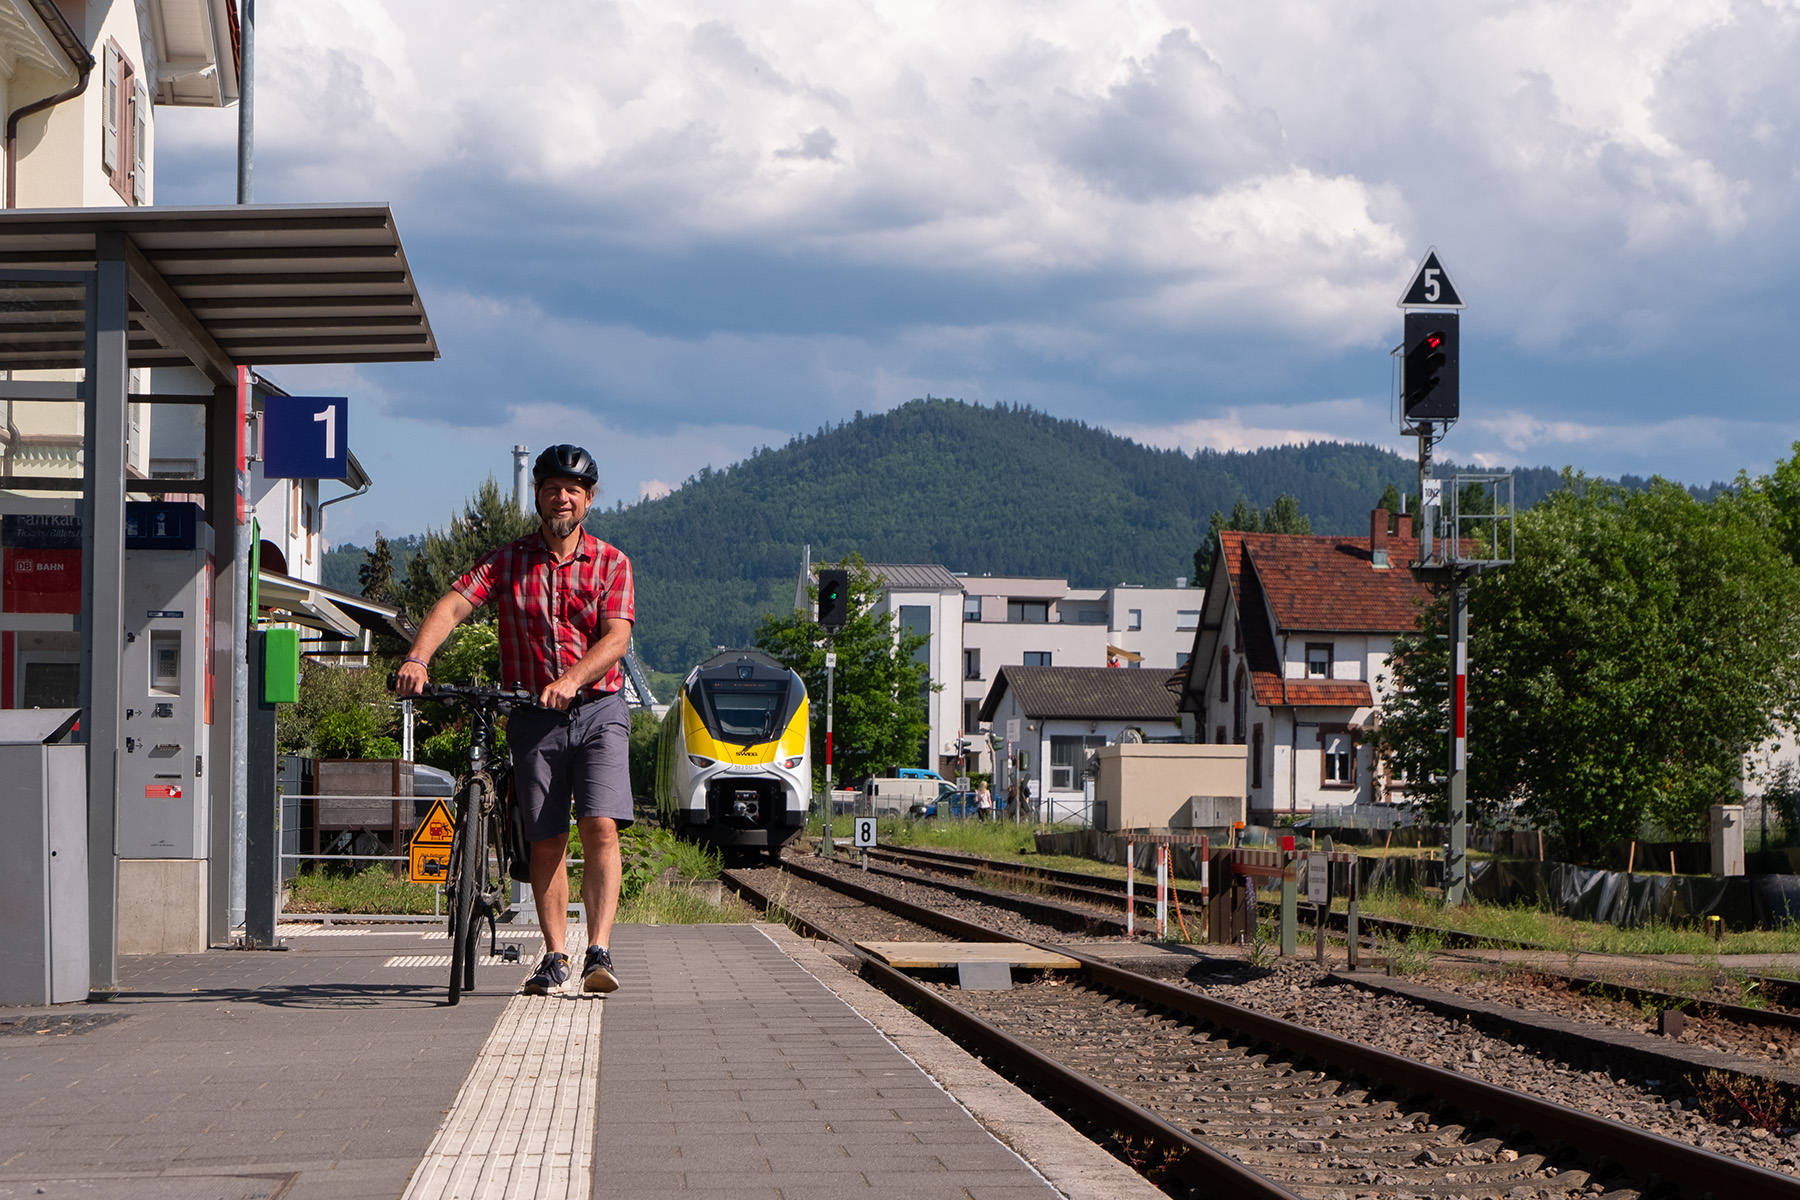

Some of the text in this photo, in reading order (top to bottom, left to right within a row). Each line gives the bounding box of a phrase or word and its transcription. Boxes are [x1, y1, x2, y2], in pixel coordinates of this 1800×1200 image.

[1424, 268, 1441, 302] 5
[313, 404, 336, 459] 1
[16, 560, 65, 573] DB BAHN
[861, 821, 871, 843] 8
